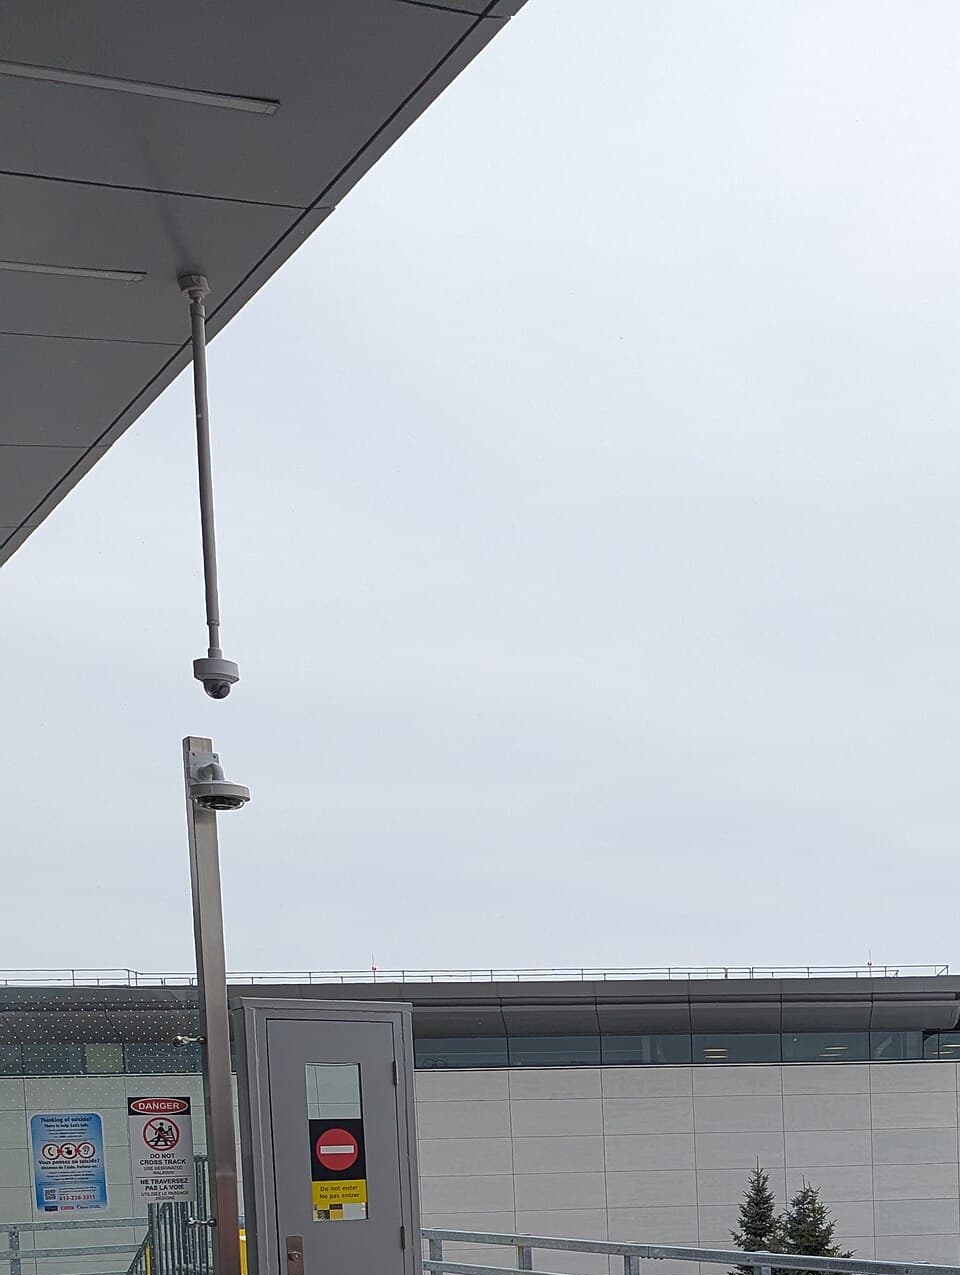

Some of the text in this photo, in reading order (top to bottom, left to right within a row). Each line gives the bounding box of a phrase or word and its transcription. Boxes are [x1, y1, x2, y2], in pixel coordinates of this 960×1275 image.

[138, 1102, 180, 1110] DANGER
[40, 1116, 63, 1124] Thinking
[150, 1177, 190, 1185] TRAVERSEZ
